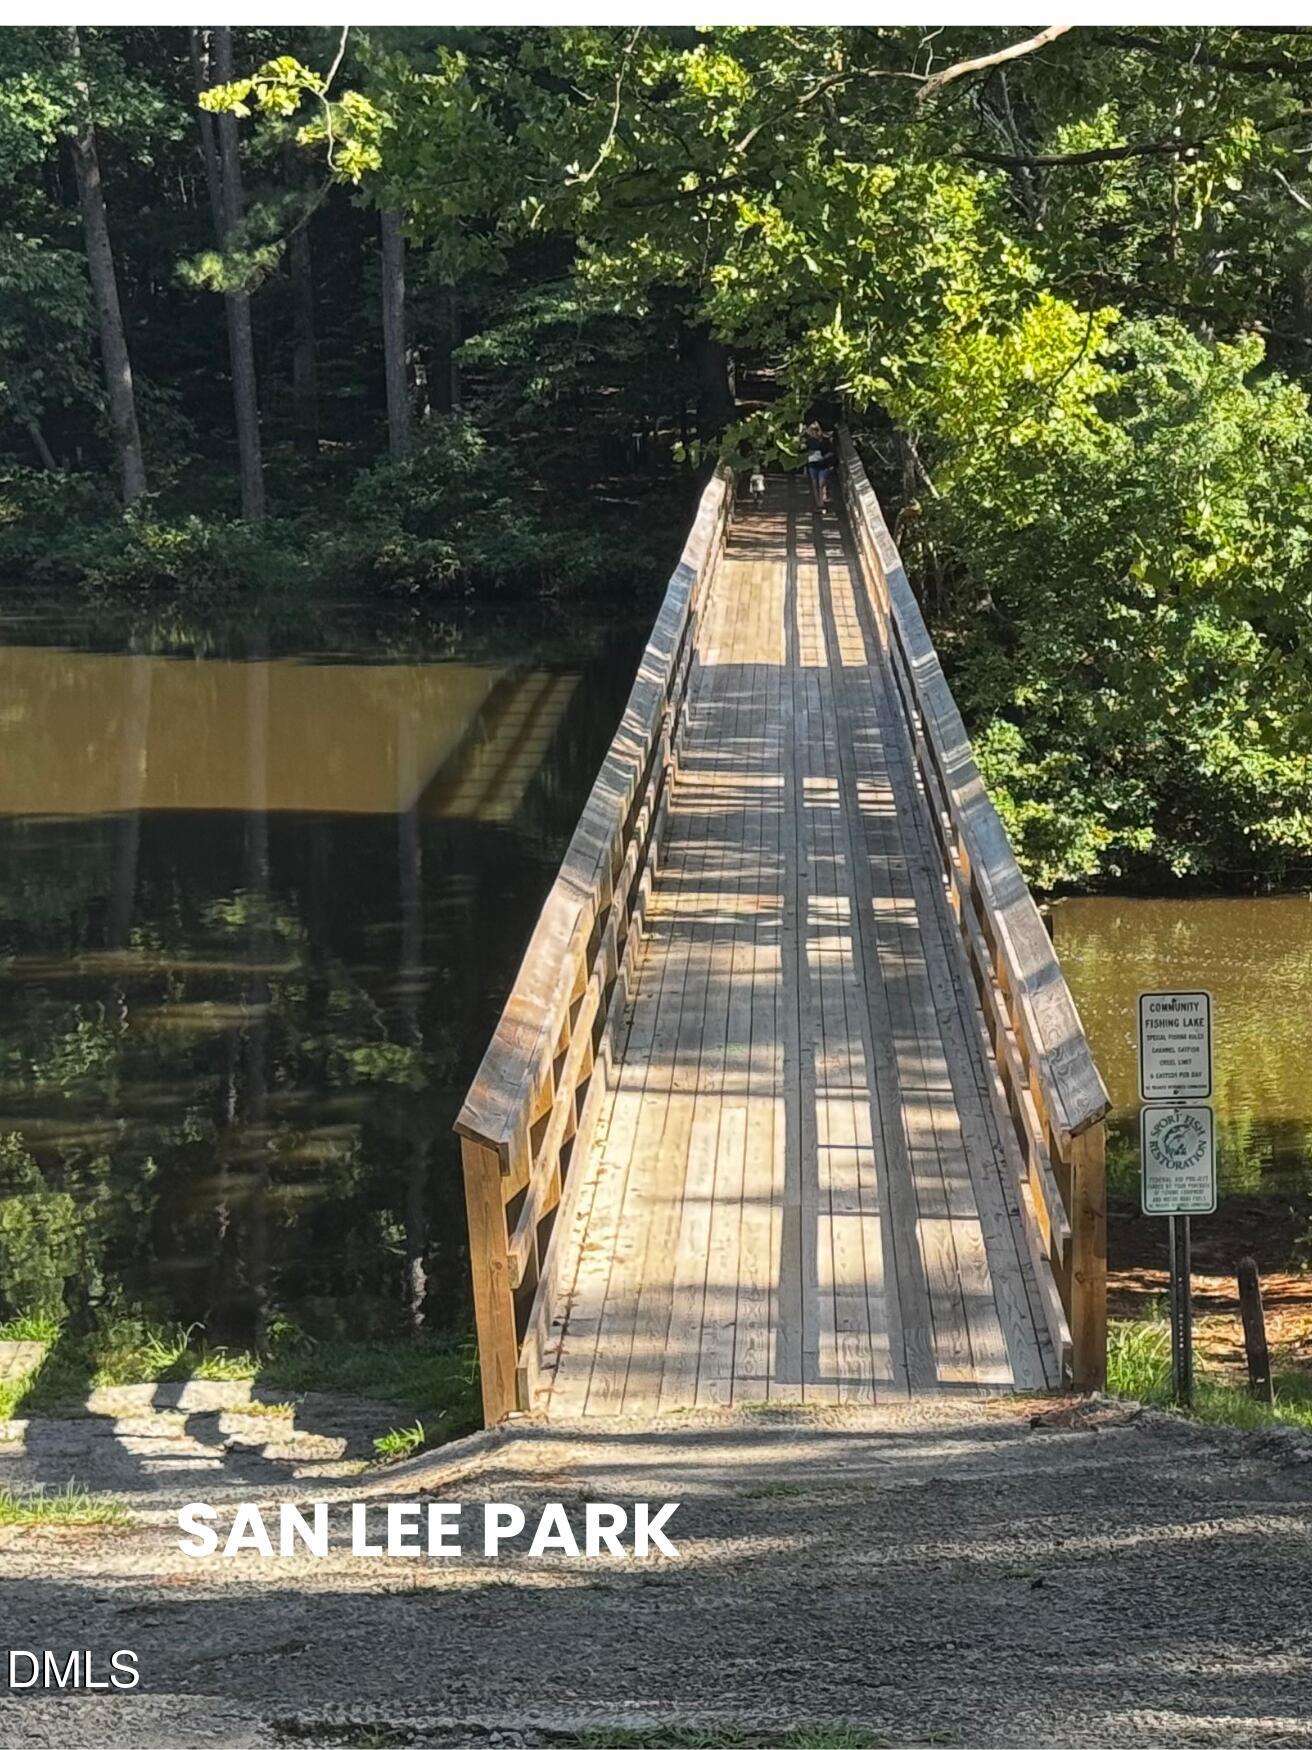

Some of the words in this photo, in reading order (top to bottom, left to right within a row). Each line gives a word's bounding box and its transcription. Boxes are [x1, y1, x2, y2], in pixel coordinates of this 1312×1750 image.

[1149, 1002, 1200, 1013] COMMUNITY
[1145, 1019, 1180, 1029] FISHING
[1183, 1018, 1205, 1028] LAKE
[1150, 1113, 1182, 1138] SPORT
[1184, 1113, 1206, 1137] FISH
[1149, 1140, 1208, 1170] RESTORATION
